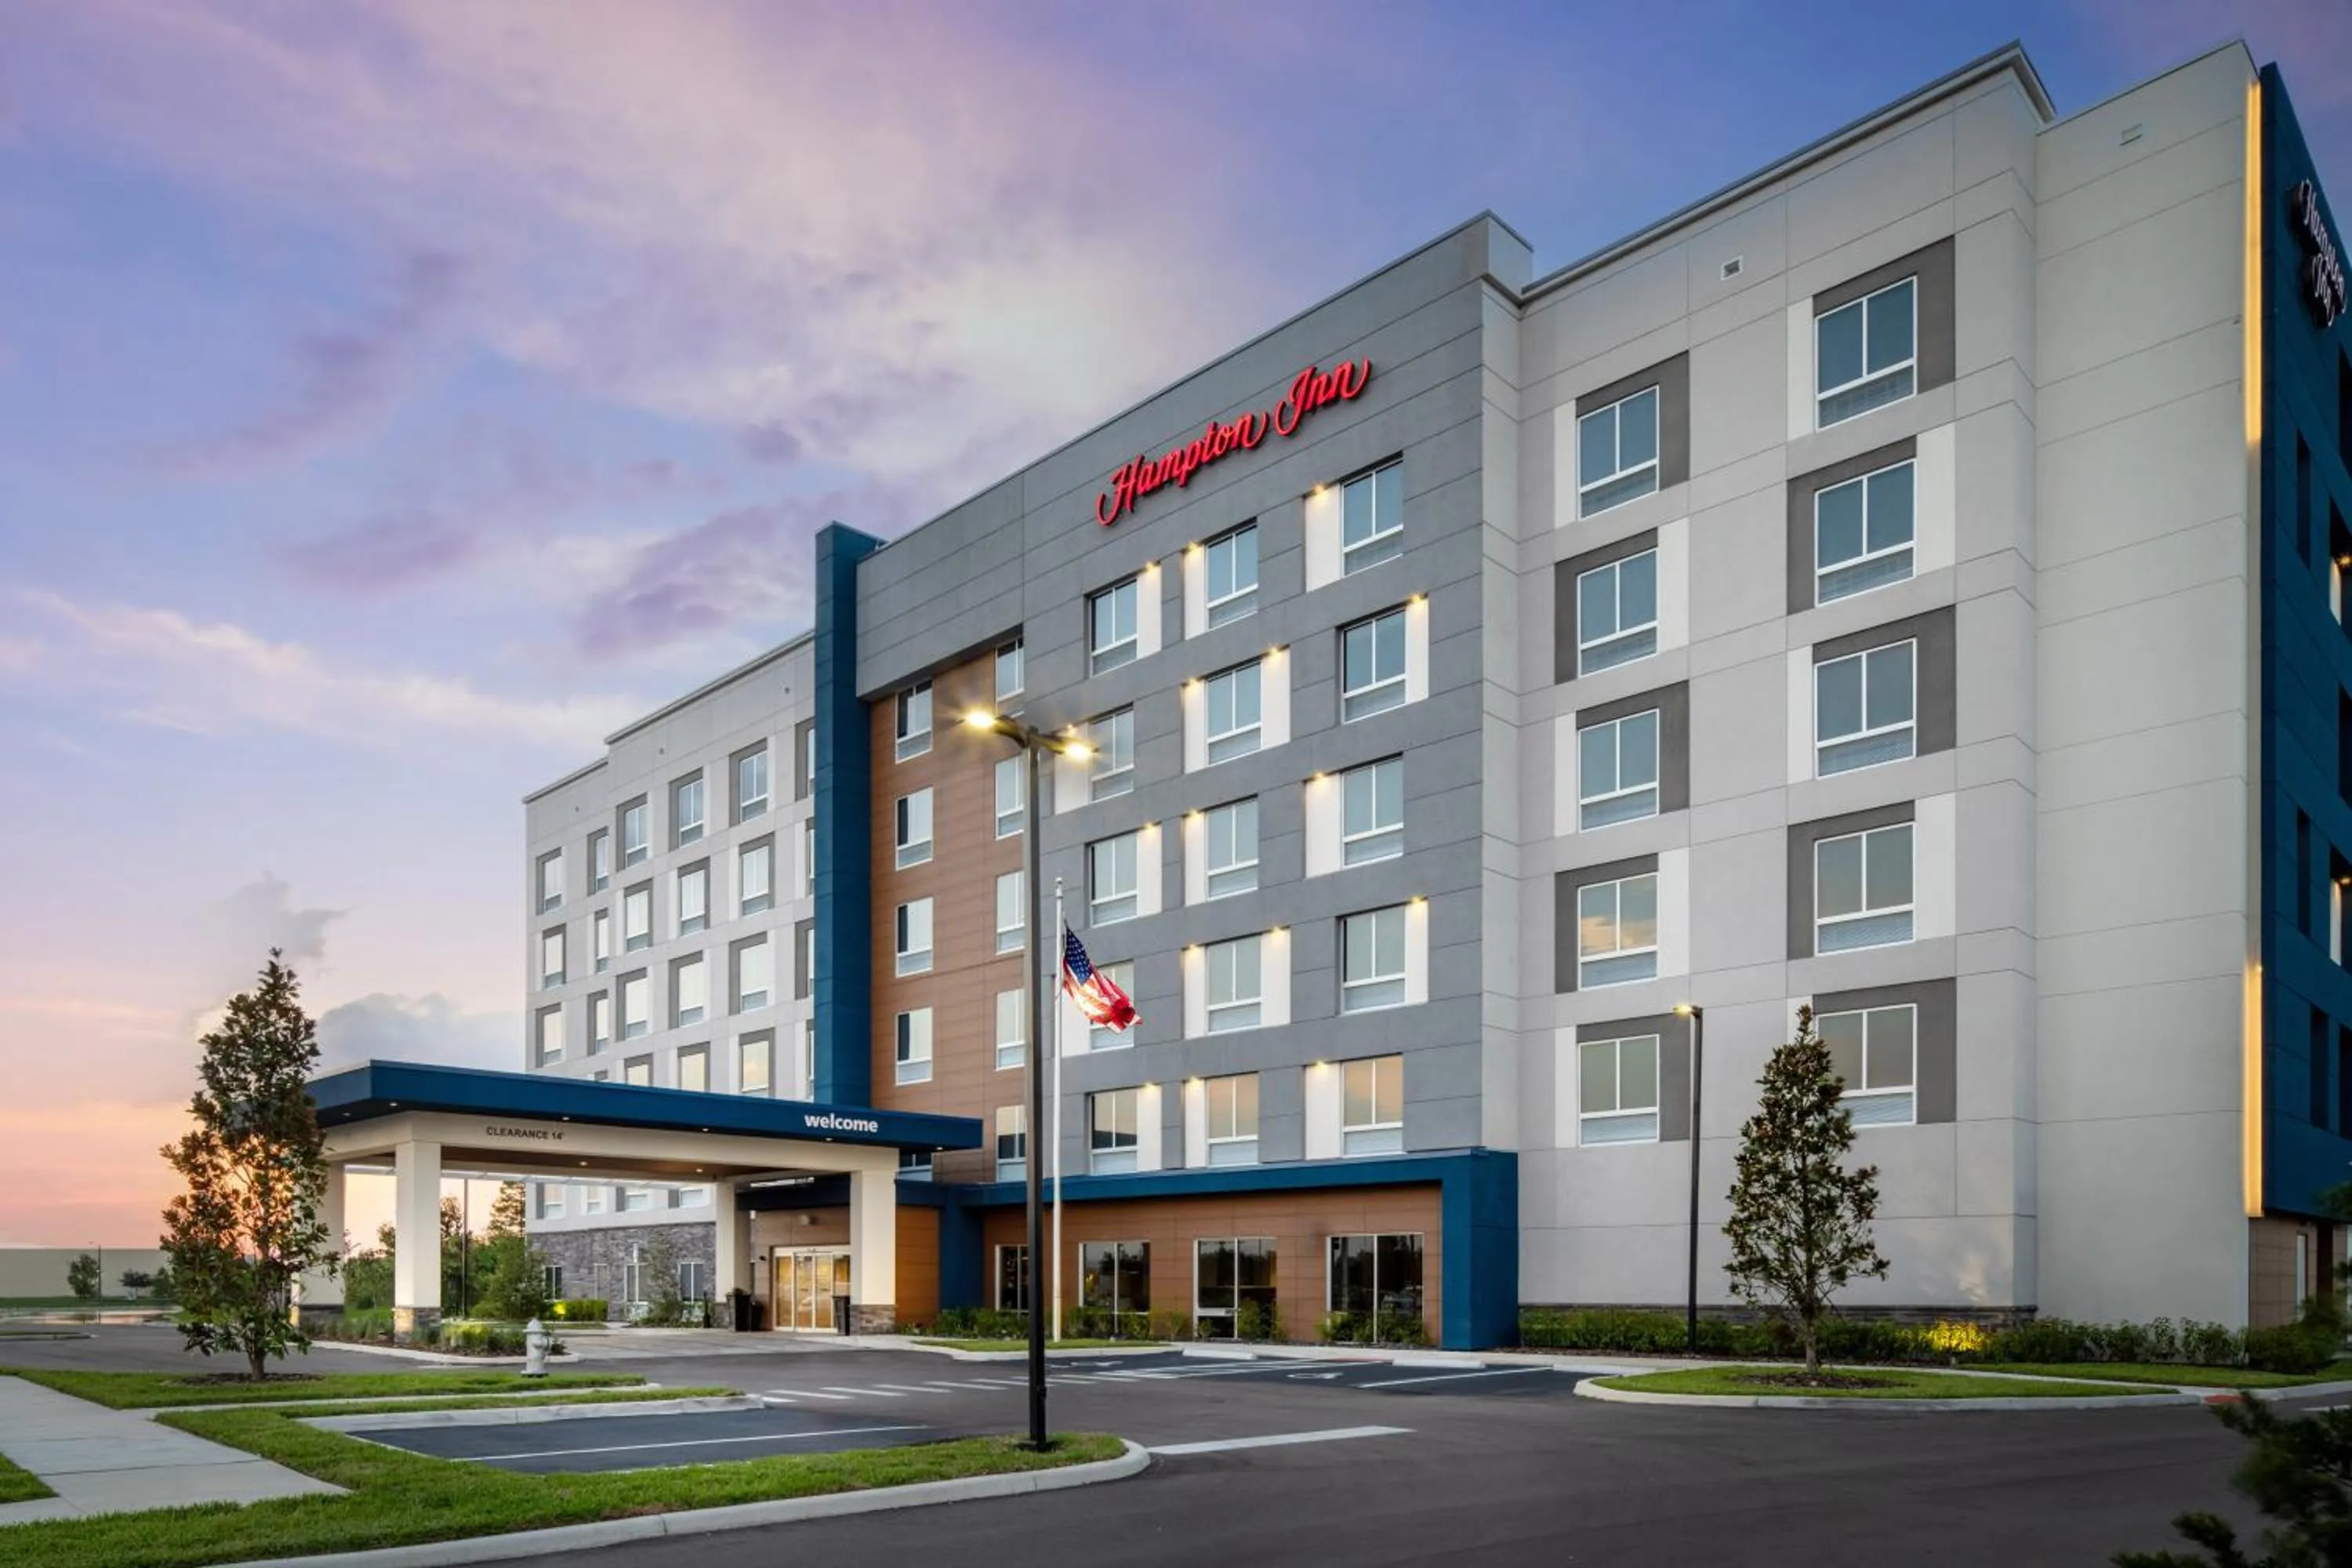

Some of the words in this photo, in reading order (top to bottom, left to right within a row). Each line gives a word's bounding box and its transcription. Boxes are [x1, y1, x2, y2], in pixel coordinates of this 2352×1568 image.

[1096, 412, 1269, 527] Hampton
[1273, 357, 1372, 437] Inn
[486, 1126, 548, 1140] CLEARANCE
[804, 1112, 878, 1133] welcome
